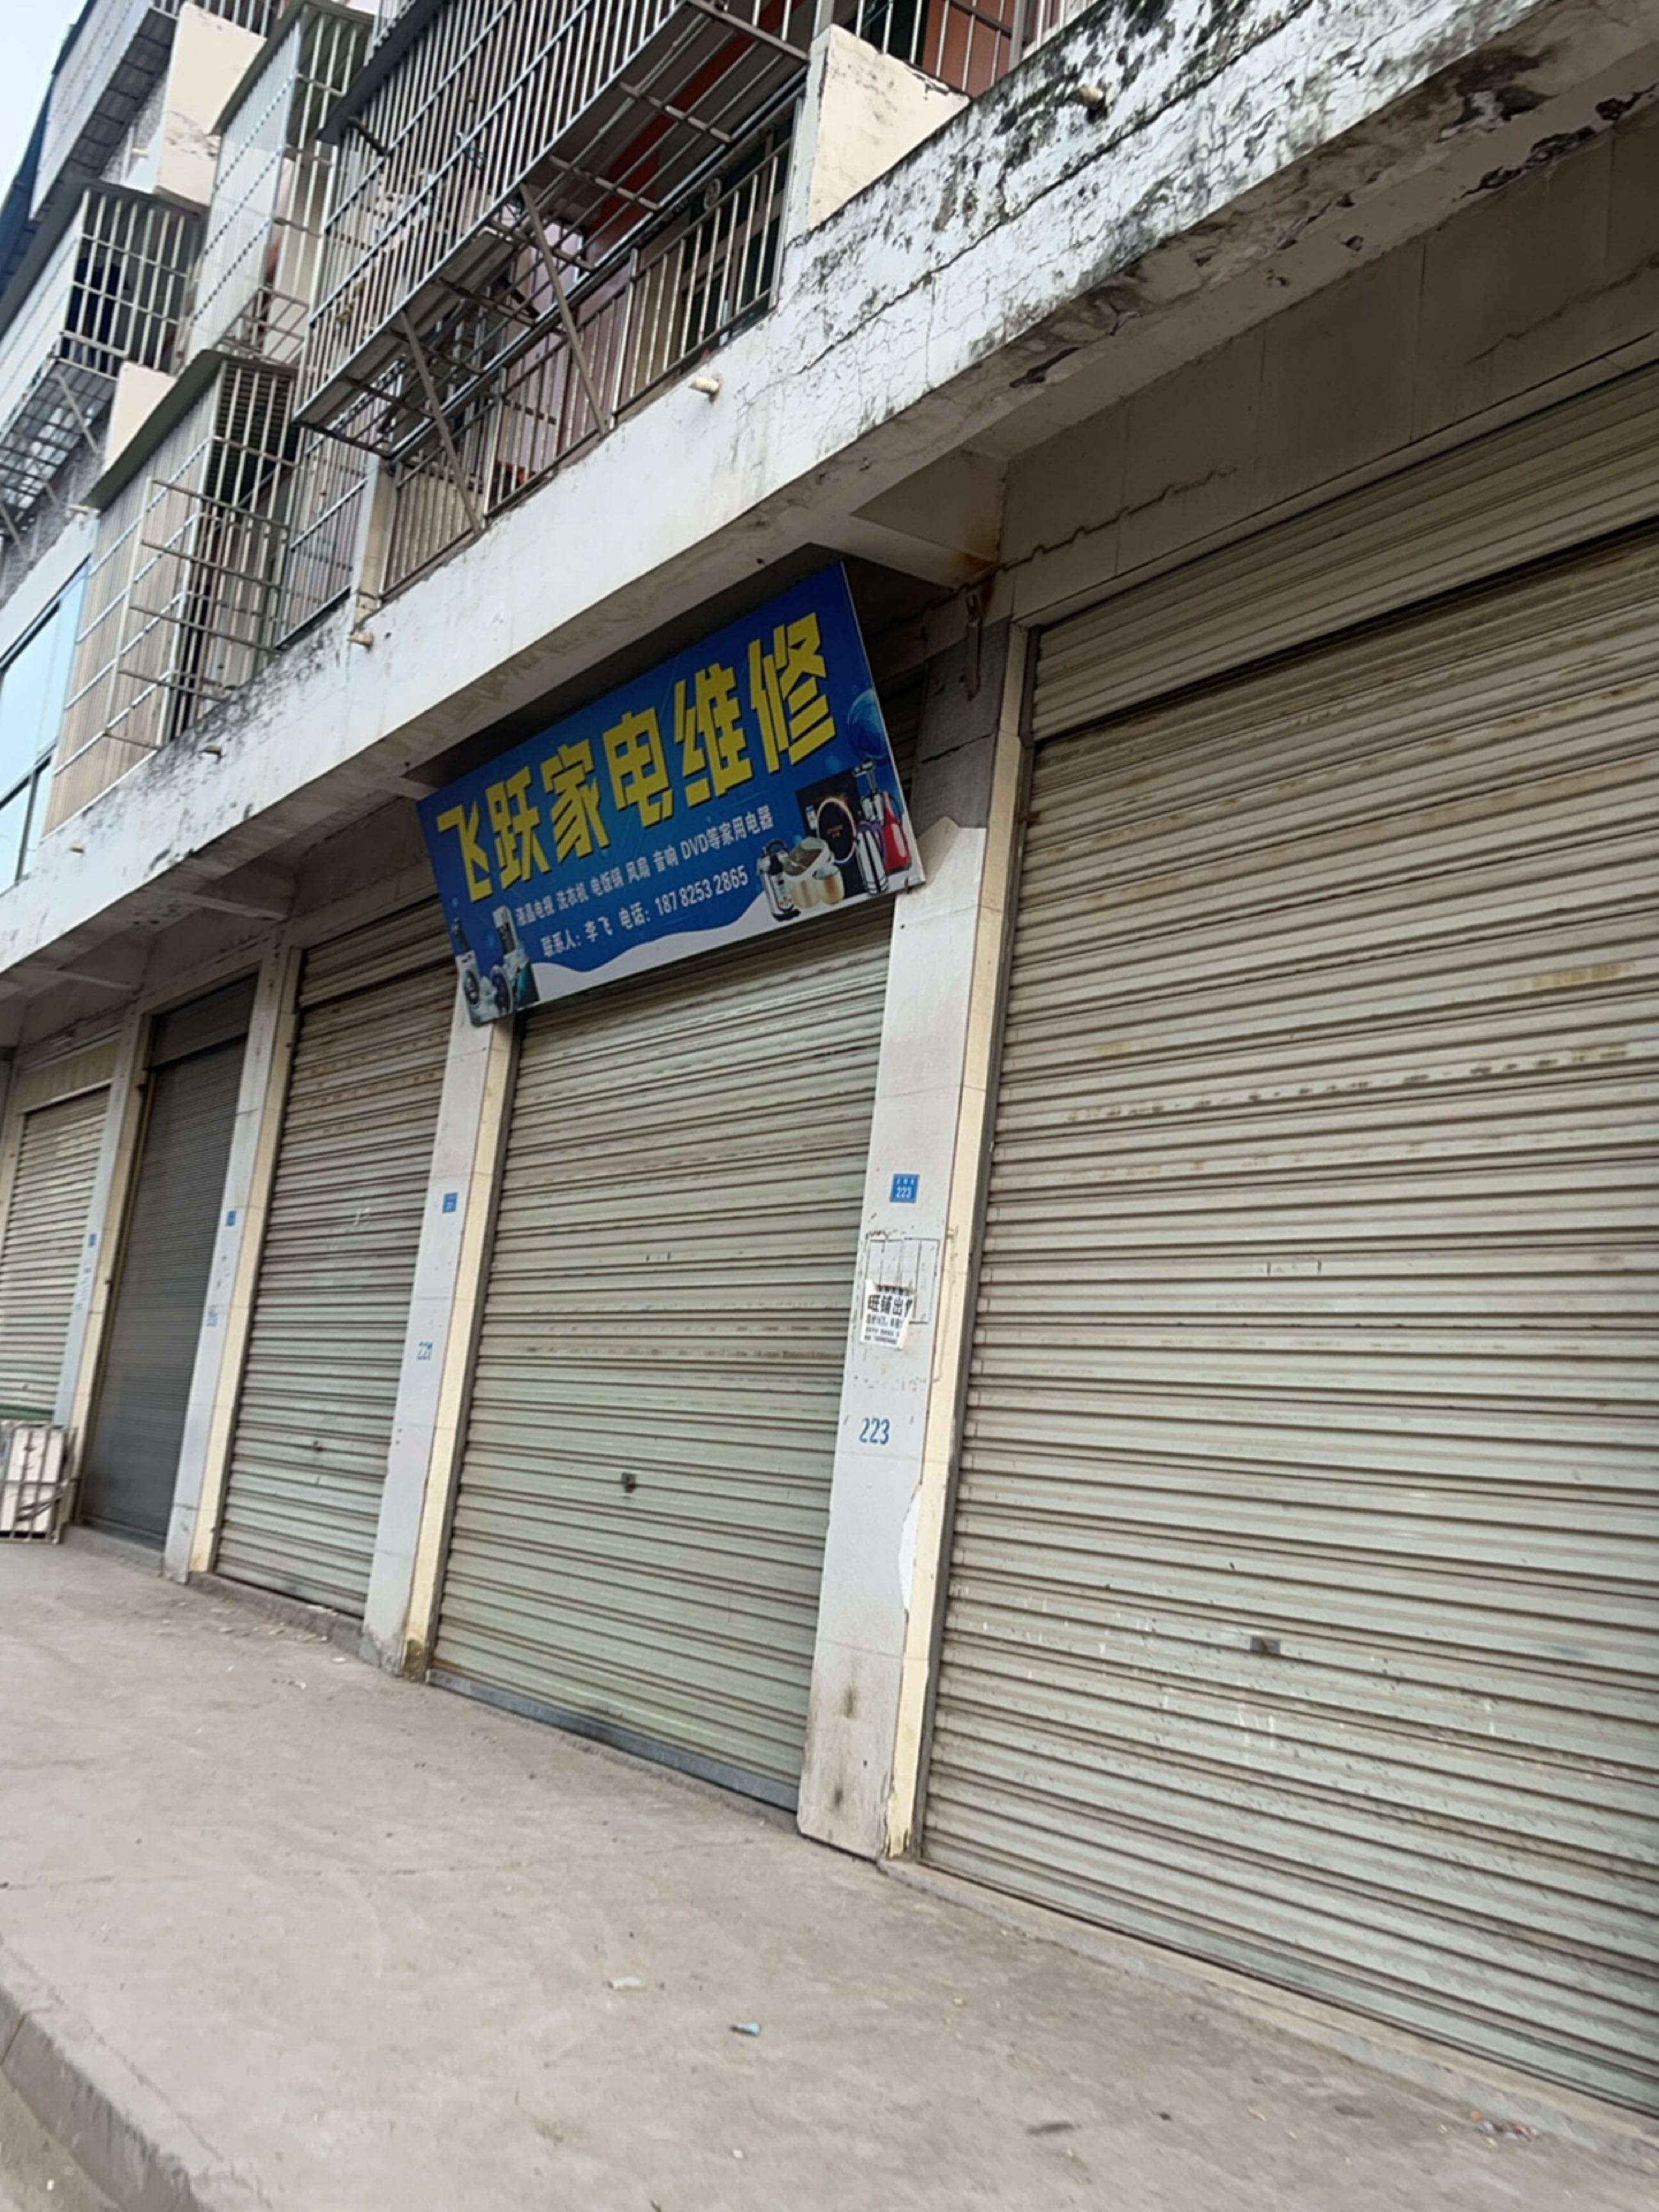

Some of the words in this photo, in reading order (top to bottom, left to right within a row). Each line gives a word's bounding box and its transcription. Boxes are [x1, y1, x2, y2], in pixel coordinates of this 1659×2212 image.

[437, 612, 837, 903] 飞跃家电维修
[859, 1416, 891, 1445] 223
